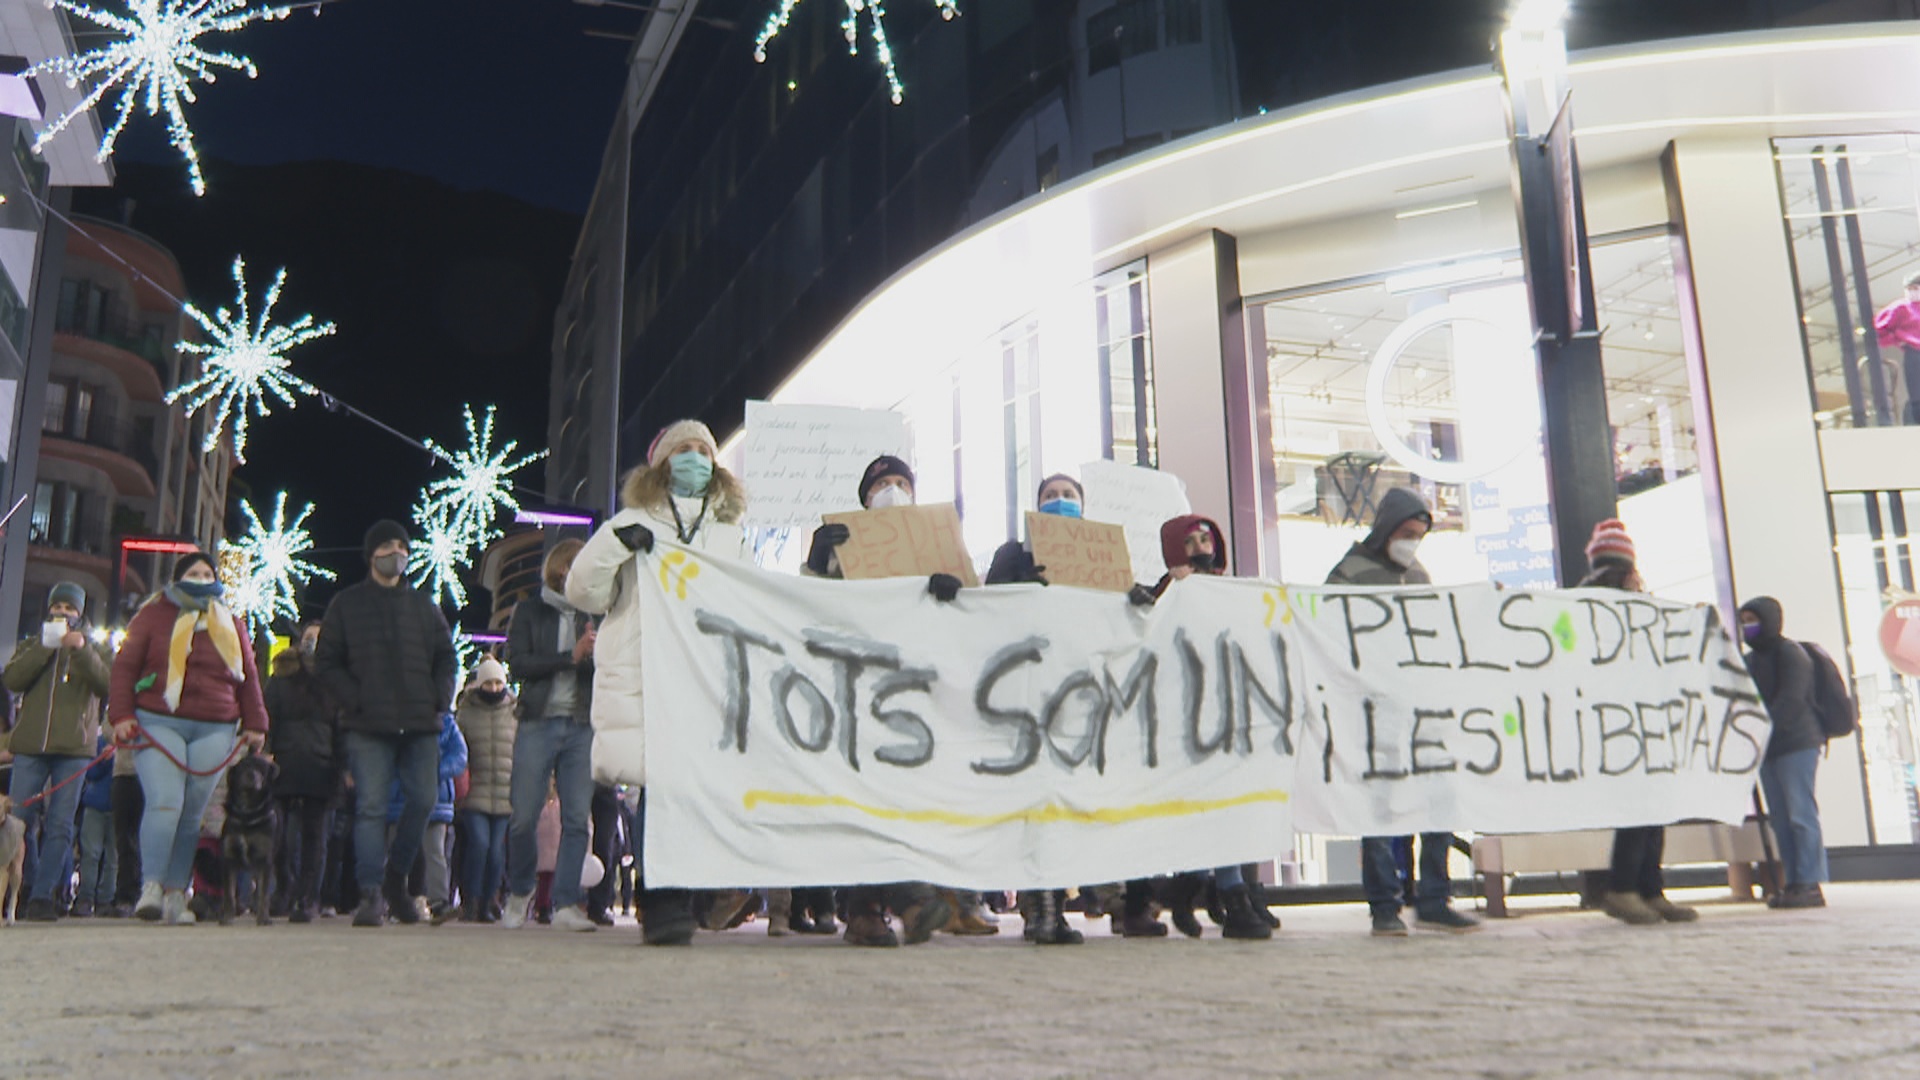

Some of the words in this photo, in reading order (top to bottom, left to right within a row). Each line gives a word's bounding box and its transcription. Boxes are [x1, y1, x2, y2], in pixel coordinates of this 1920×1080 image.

[1064, 522, 1118, 546] VULL
[1087, 547, 1114, 563] UN
[1322, 593, 1554, 671] PELS
[695, 608, 937, 772] TOTS
[970, 636, 1159, 775] SOM
[1174, 626, 1294, 765] UN
[1363, 698, 1502, 780] LES
